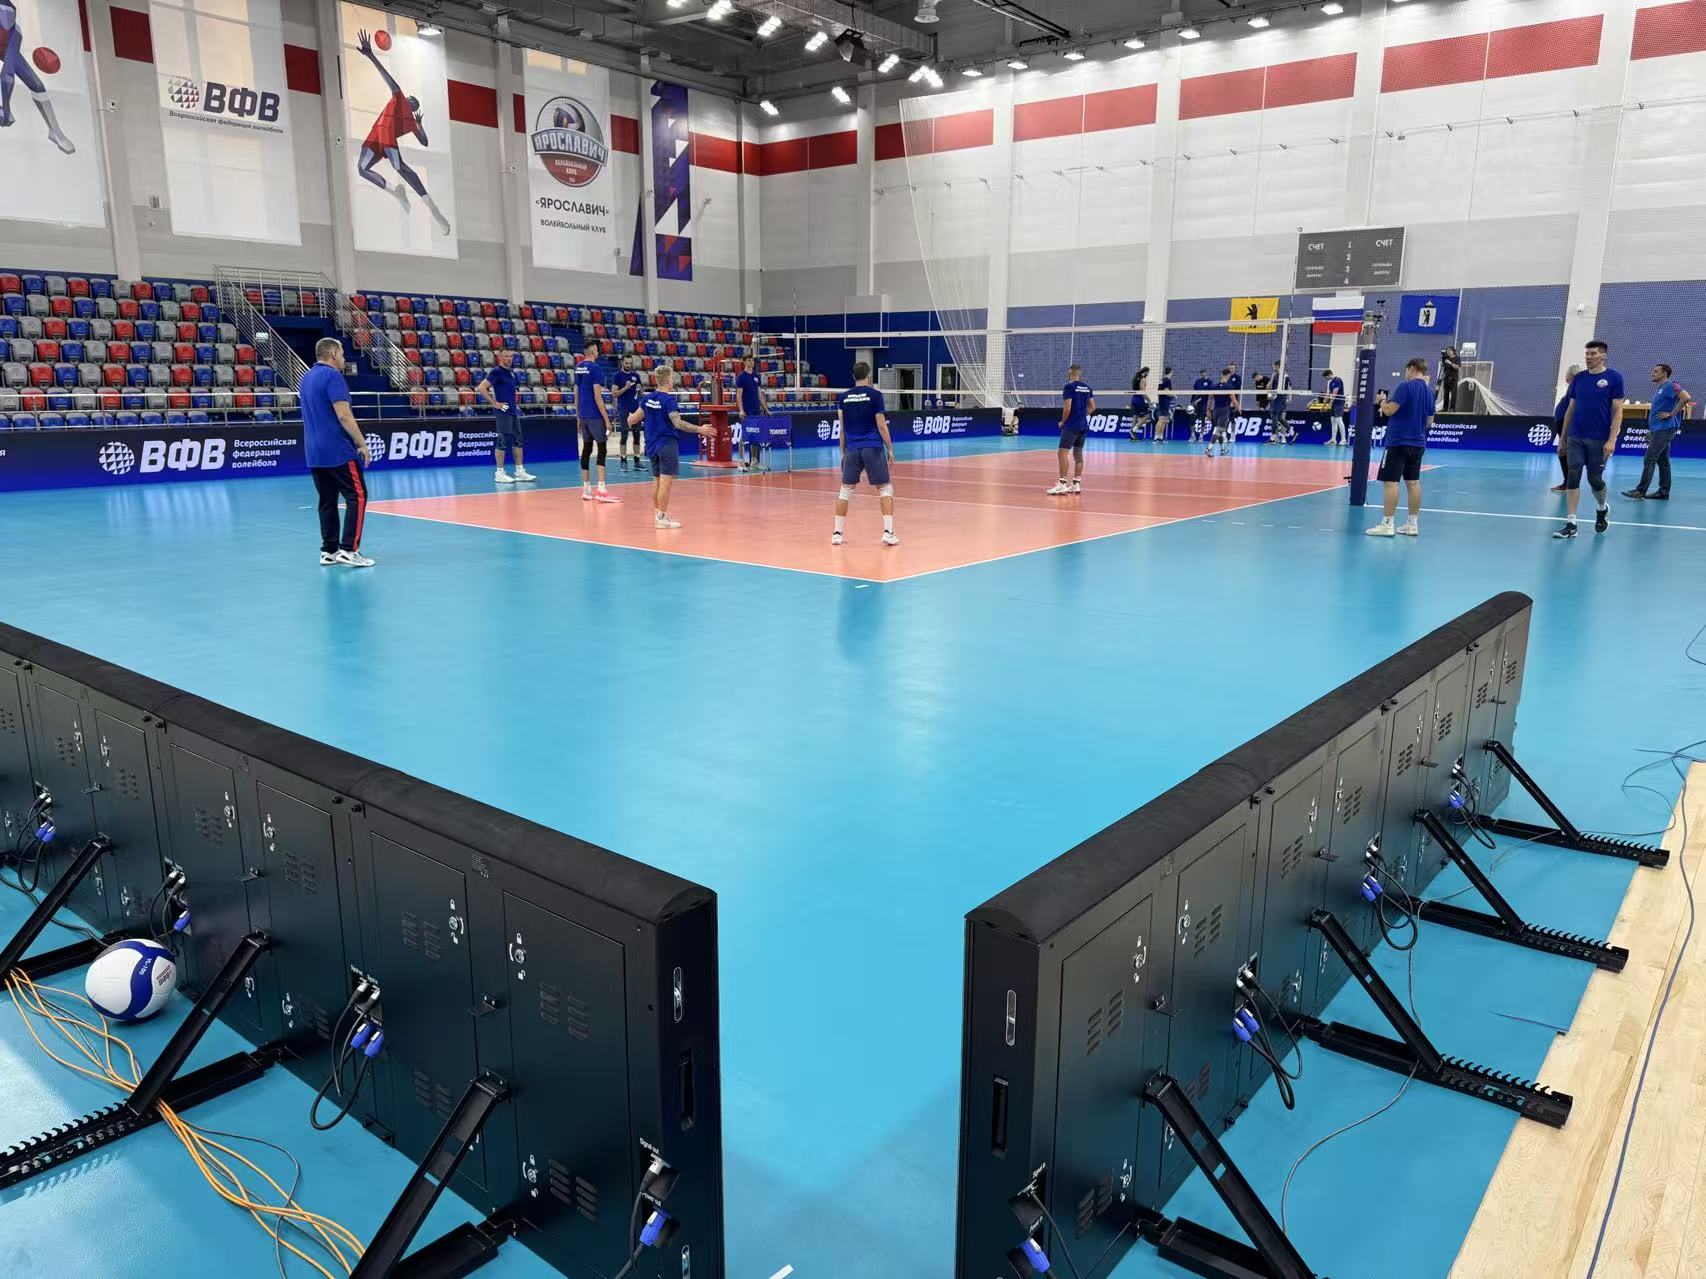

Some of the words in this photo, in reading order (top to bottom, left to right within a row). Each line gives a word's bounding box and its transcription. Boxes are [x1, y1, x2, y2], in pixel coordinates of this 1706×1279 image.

[203, 81, 280, 122] ВФВ
[169, 110, 217, 124] Всероссийская
[534, 132, 605, 162] ЯРОСЛАВИЧ
[535, 197, 609, 217] «ЯРОСЛАВИЧ»
[540, 219, 590, 232] ВОЛЕЙБОЛЬНЫЙ
[591, 226, 606, 234] КЛУБ
[1307, 243, 1325, 251] СЧЕТ
[1375, 239, 1393, 247] СЧЕТ
[1346, 253, 1351, 261] 2
[1345, 265, 1350, 273] 3
[923, 415, 951, 434] ВФВ
[1086, 414, 1119, 432] ФВ
[1431, 422, 1477, 430] Всероссийская
[458, 431, 498, 439] Всероссийск
[234, 438, 297, 447] Всероссийская
[388, 430, 453, 460] ВФВ
[457, 440, 494, 449] федерация
[140, 439, 226, 473] ВФВ
[232, 448, 281, 459] федерация
[456, 449, 491, 457] волейбола
[232, 459, 277, 469] волейбола
